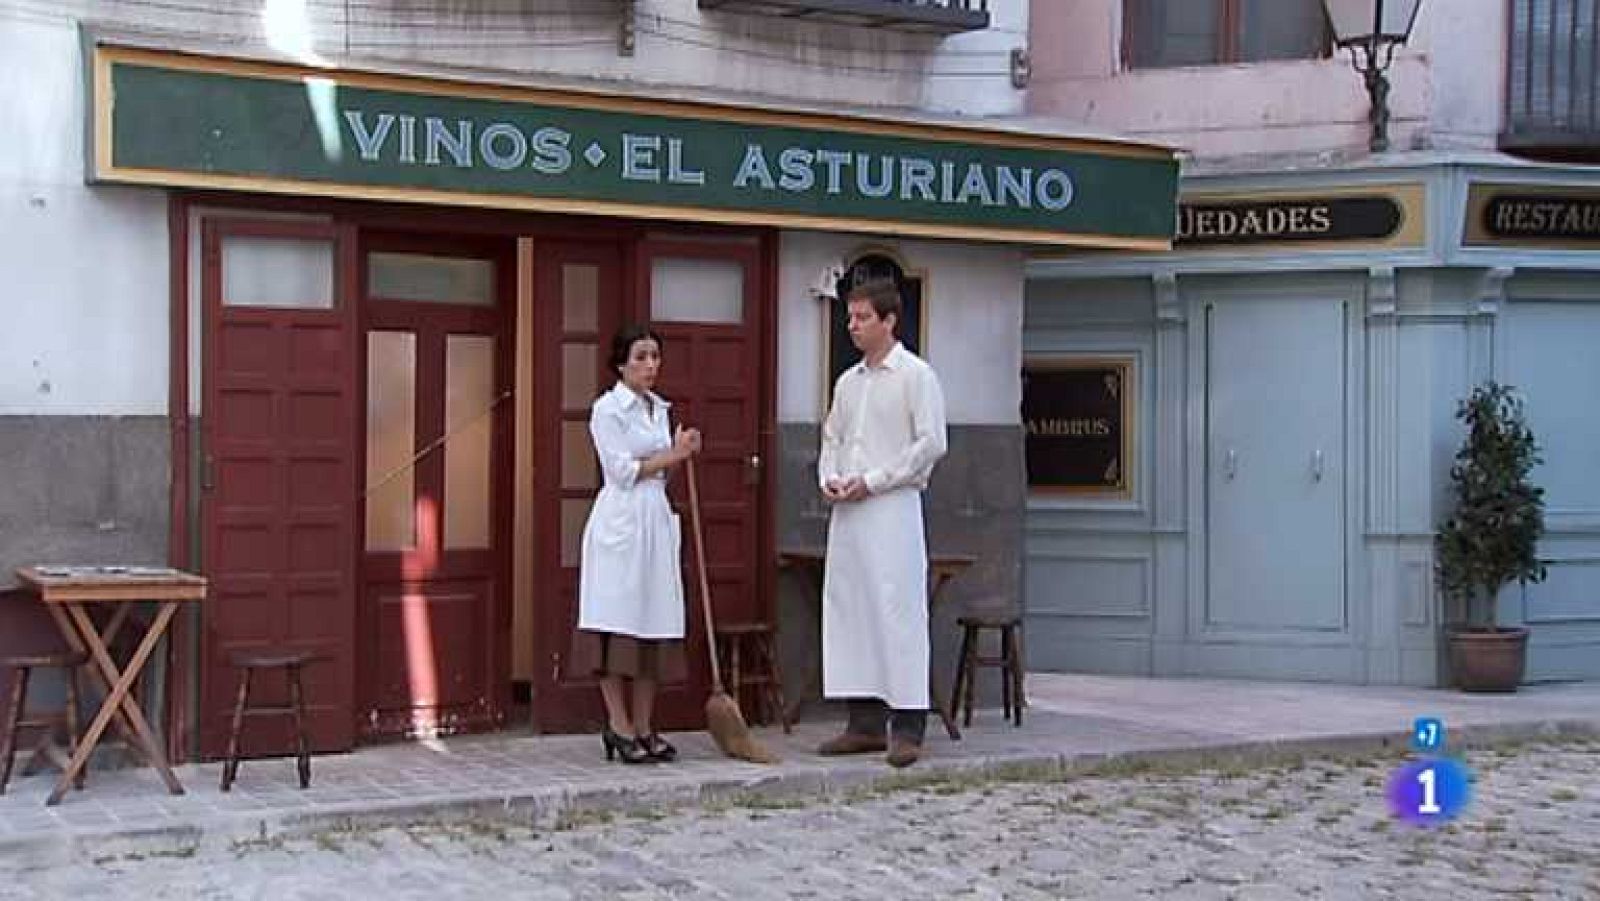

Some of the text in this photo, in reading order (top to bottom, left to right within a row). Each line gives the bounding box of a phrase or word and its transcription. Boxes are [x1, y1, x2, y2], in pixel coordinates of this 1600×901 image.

[344, 111, 1074, 210] VINOS EL ASTURIANO
